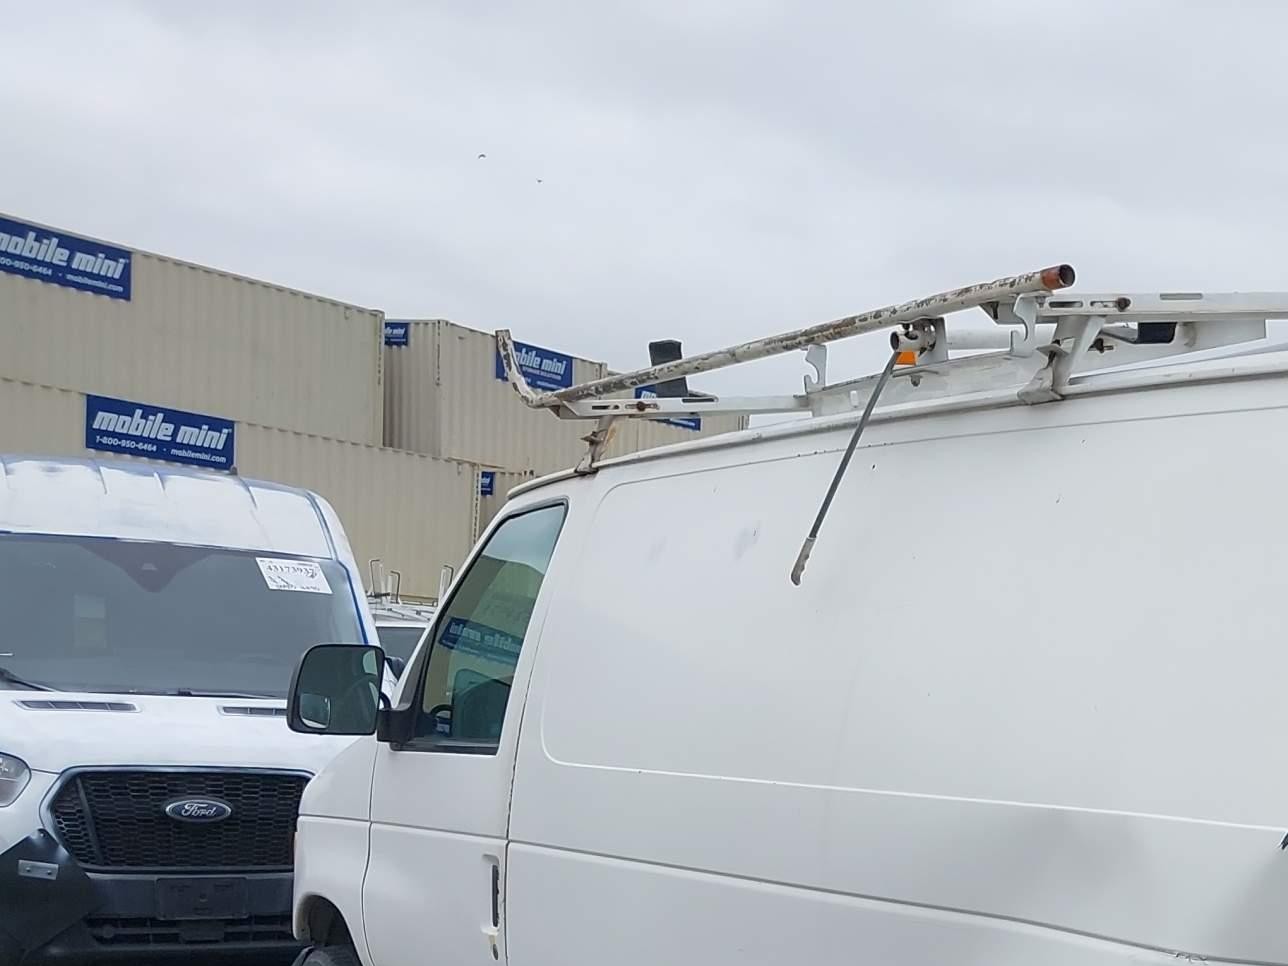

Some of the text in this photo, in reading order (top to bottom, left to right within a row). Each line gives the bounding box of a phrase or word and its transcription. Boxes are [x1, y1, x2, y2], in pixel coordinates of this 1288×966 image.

[71, 251, 126, 279] mini
[515, 347, 541, 369] obile
[541, 358, 567, 375] mini
[92, 409, 228, 450] mobile mini
[95, 435, 157, 452] 1-800-950-6464
[170, 448, 227, 463] mobilemini.com
[181, 803, 217, 817] Ford
